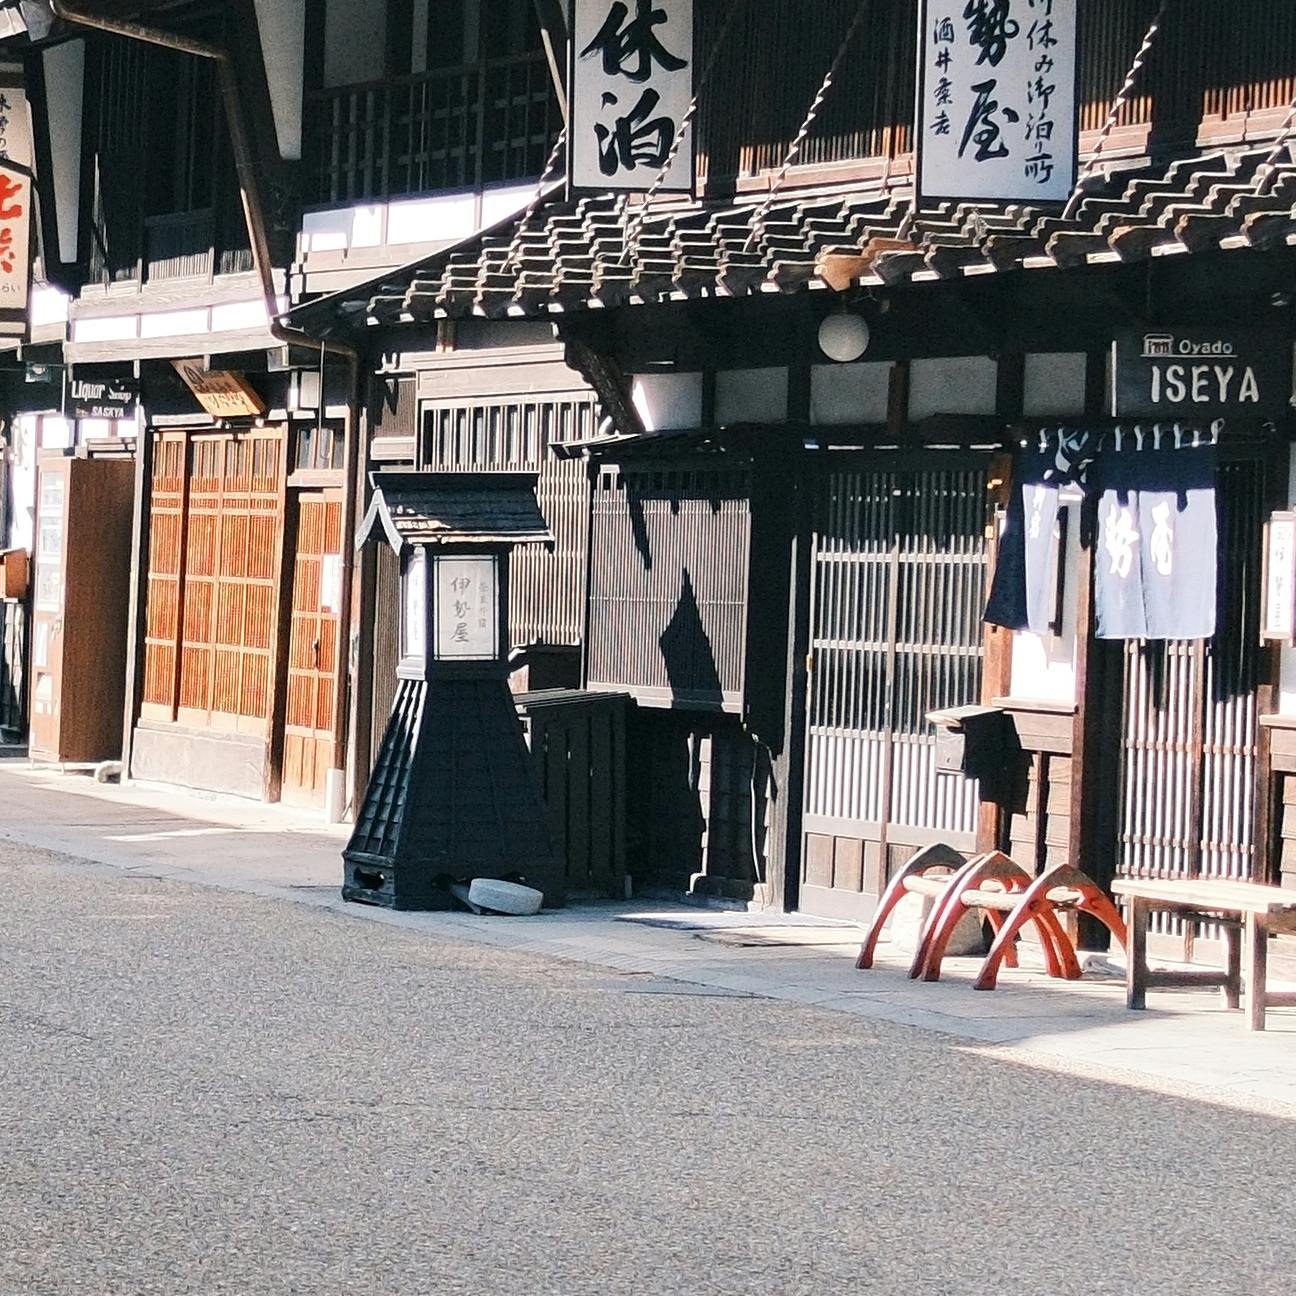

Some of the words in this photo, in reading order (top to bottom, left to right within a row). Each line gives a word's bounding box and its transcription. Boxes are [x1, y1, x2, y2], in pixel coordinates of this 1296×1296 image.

[1179, 340, 1233, 354] Oyado
[71, 380, 106, 402] Liquor
[1151, 364, 1260, 403] ISEYA
